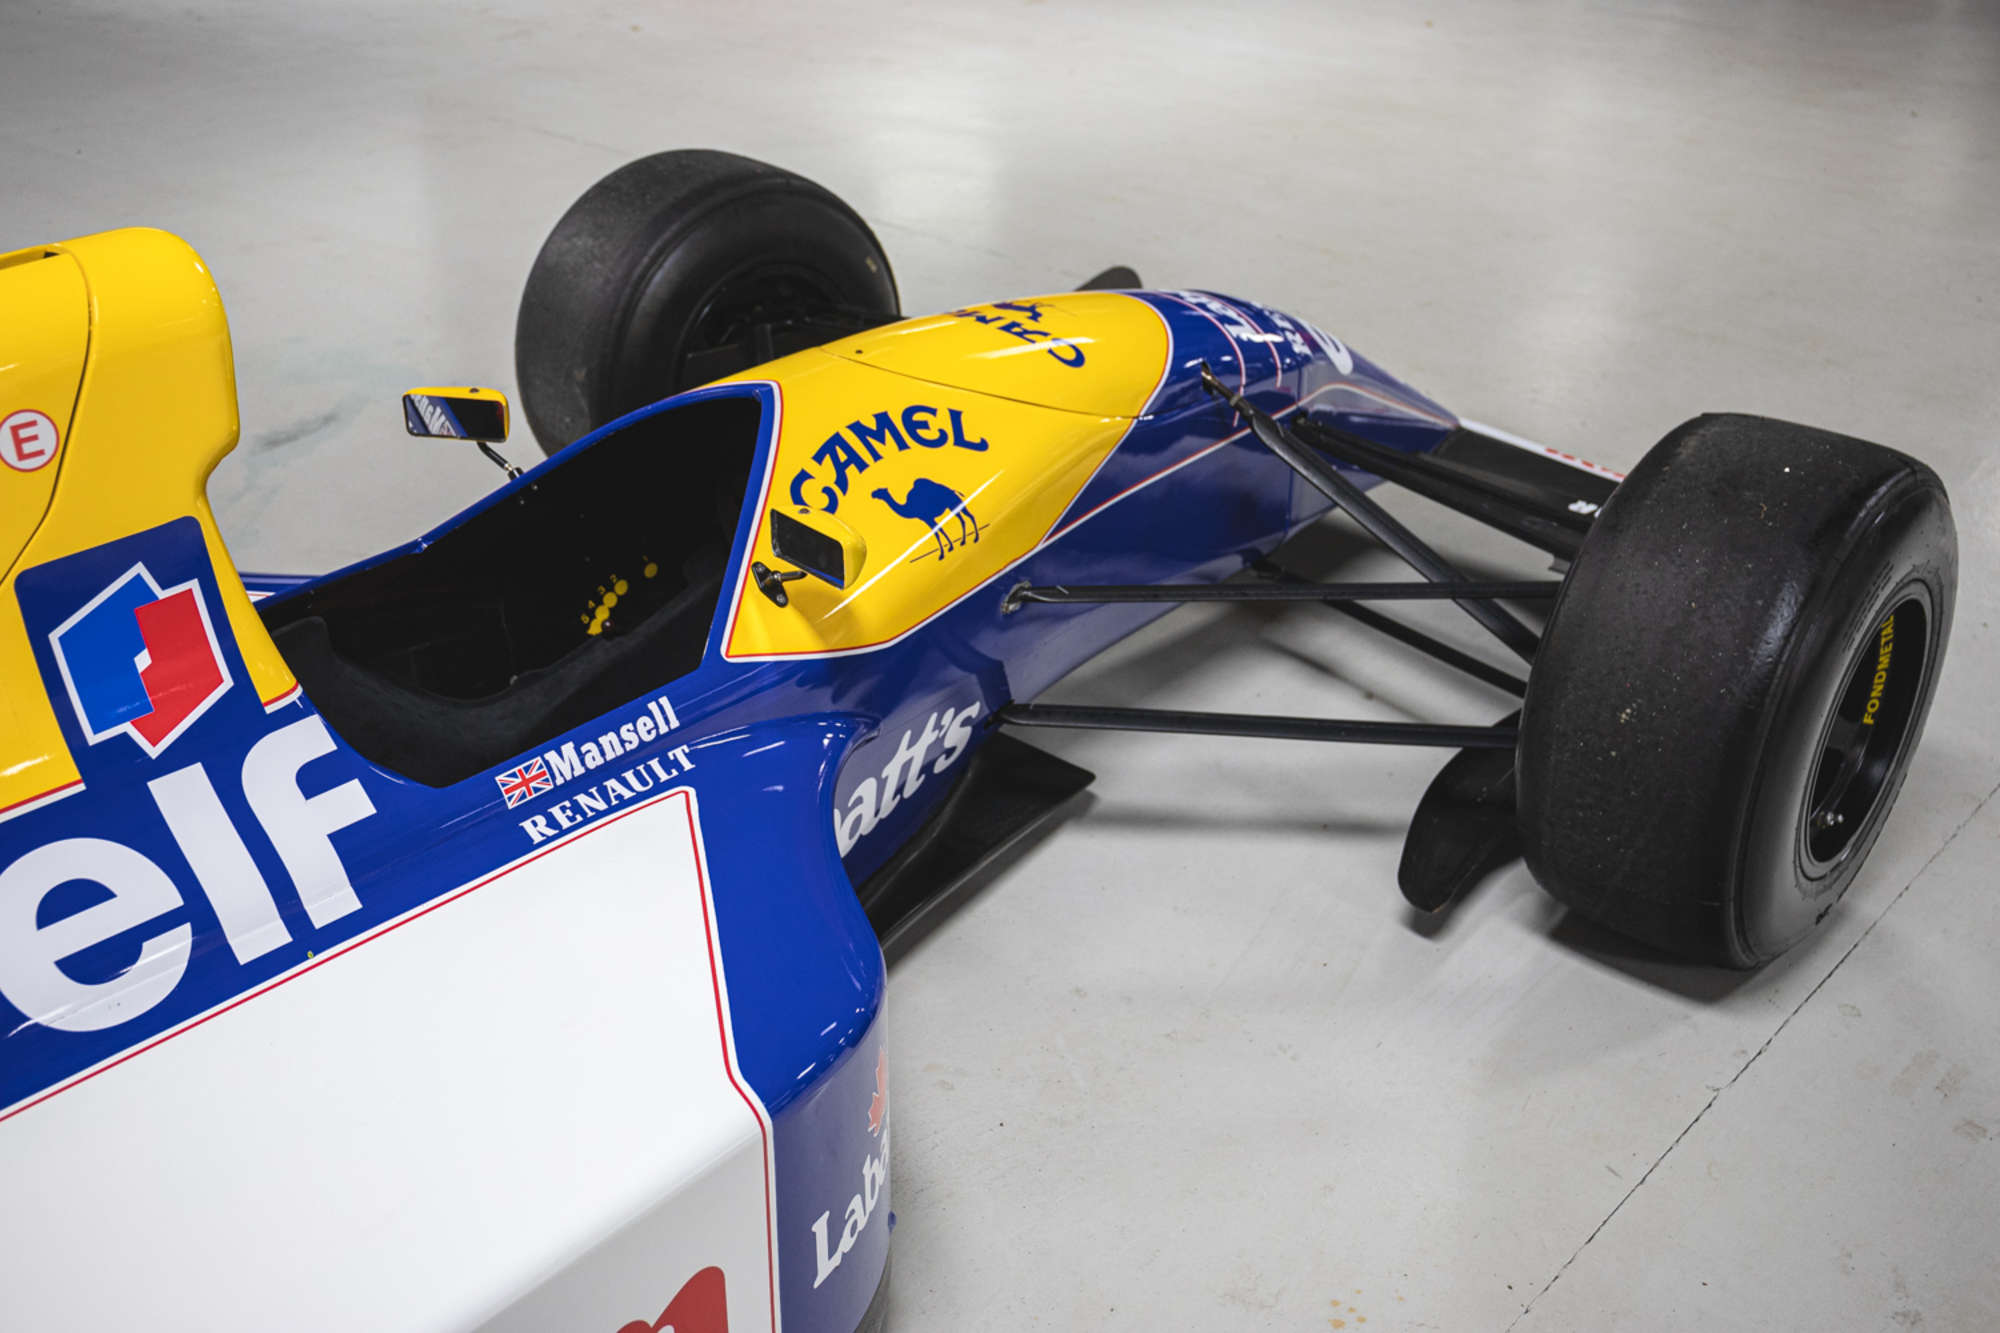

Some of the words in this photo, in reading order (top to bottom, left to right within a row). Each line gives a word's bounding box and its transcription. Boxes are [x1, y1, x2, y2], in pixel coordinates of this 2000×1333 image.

[9, 419, 46, 462] E
[789, 404, 989, 515] CAMEL
[1863, 614, 1895, 725] FONDMETAL
[543, 695, 681, 787] Mansell
[518, 744, 696, 845] RENAULT
[0, 713, 378, 1033] elf
